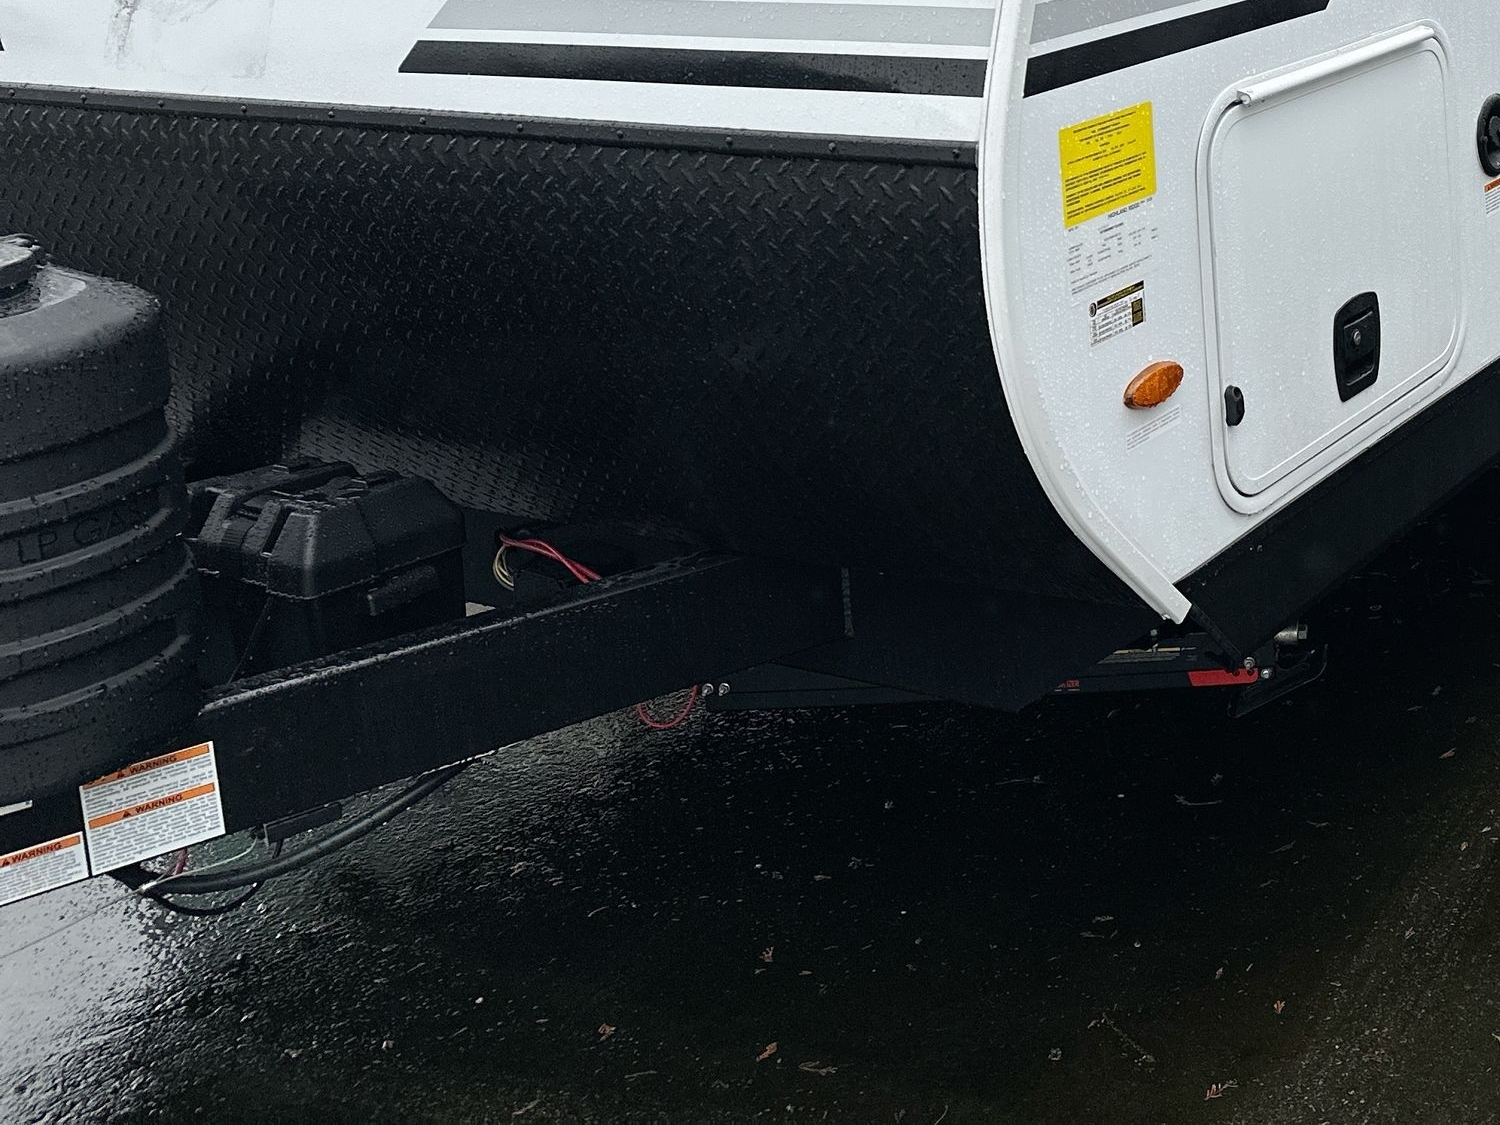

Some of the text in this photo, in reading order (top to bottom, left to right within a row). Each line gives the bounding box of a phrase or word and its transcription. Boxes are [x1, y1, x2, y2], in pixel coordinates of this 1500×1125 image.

[17, 532, 58, 564] LP
[129, 755, 178, 774] WARNING
[135, 794, 183, 813] WARNING
[11, 842, 62, 863] WARNING
